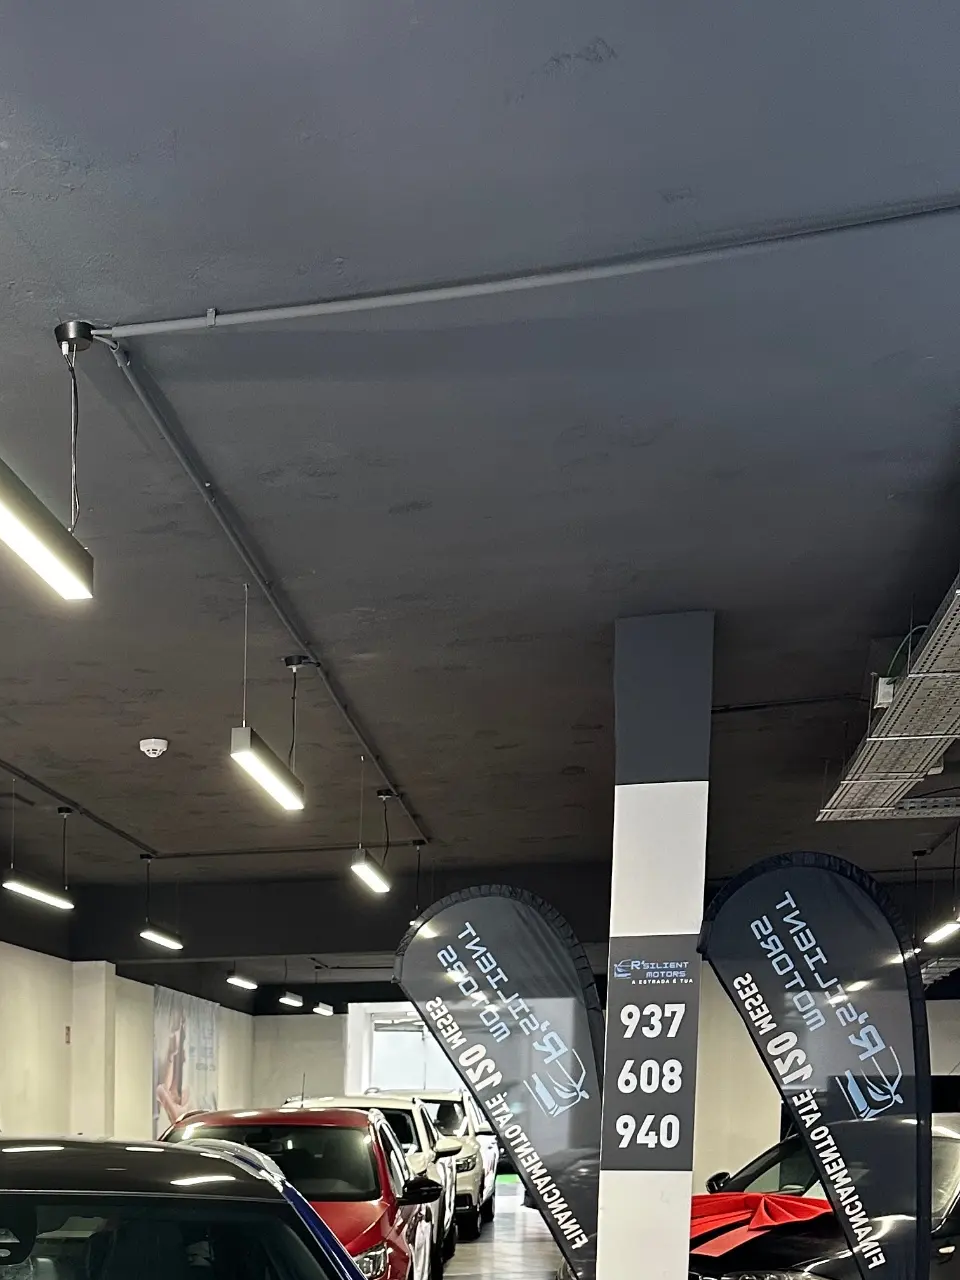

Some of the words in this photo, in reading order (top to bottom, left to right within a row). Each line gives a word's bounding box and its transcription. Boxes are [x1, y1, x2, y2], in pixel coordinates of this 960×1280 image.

[646, 970, 686, 979] MOTORS
[620, 1004, 686, 1039] 937
[617, 1059, 683, 1094] 608
[615, 1114, 680, 1149] 940
